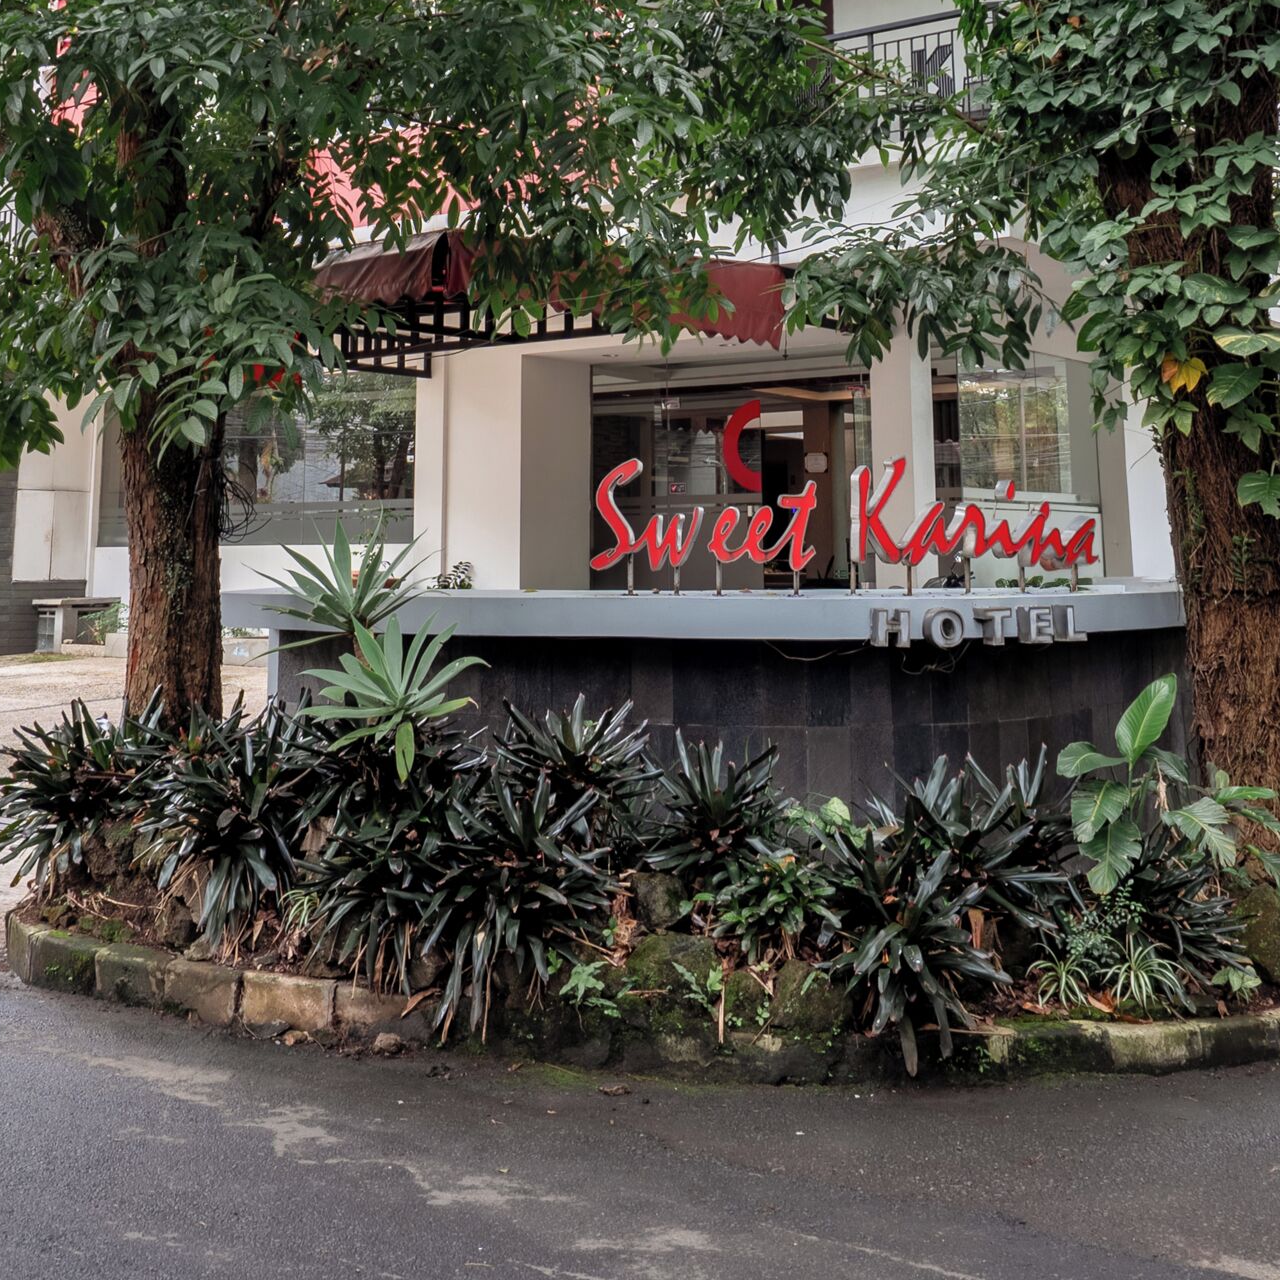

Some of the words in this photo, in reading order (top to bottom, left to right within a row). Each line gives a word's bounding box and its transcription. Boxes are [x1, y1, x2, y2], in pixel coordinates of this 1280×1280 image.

[589, 457, 817, 572] Sweet
[850, 456, 1101, 568] Karina
[870, 604, 1089, 650] HOTEL
